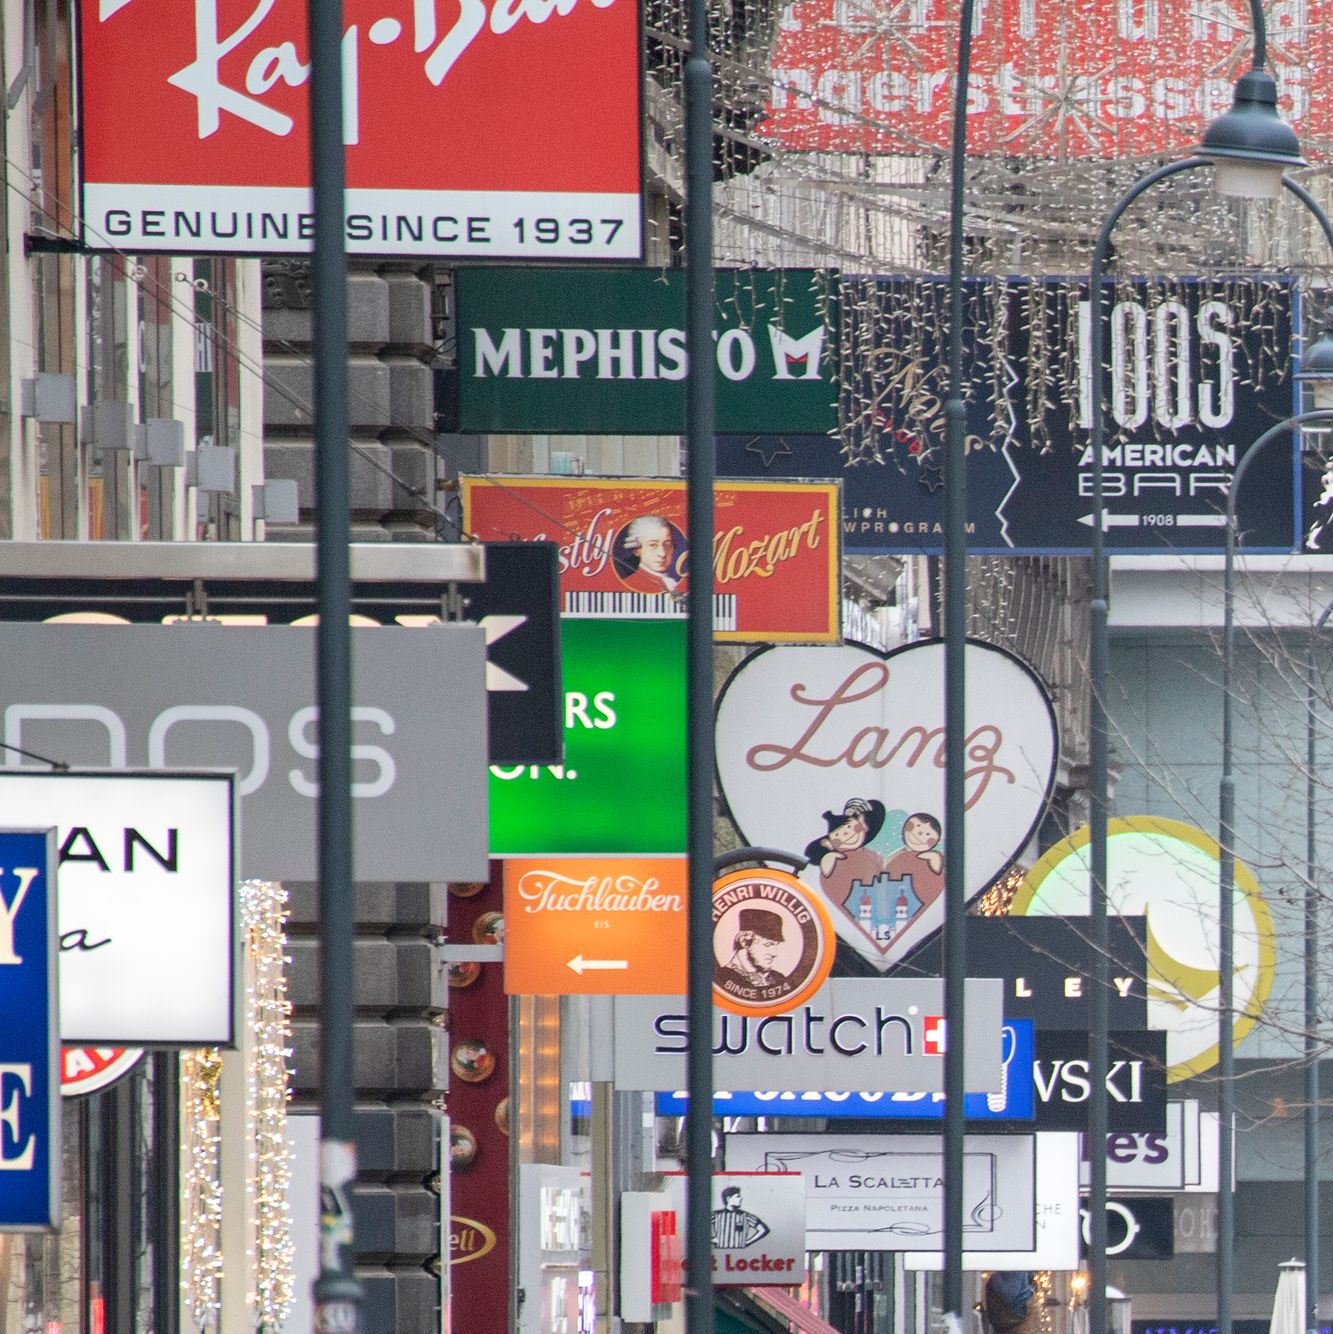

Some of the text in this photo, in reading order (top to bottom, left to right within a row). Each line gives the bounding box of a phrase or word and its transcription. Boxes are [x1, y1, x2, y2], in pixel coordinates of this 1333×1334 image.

[104, 209, 625, 246] GENUINE SINCE 1937
[471, 327, 756, 381] MEPHISO
[1078, 443, 1235, 467] AMERICAN
[1078, 472, 1234, 496] BAR
[1142, 514, 1174, 527] 1908
[518, 870, 684, 914] Tuchlauben
[760, 885, 811, 924] WILLIG
[724, 980, 791, 999] SINCE 1974
[653, 1006, 913, 1057] swatch
[725, 1254, 796, 1272] Locker
